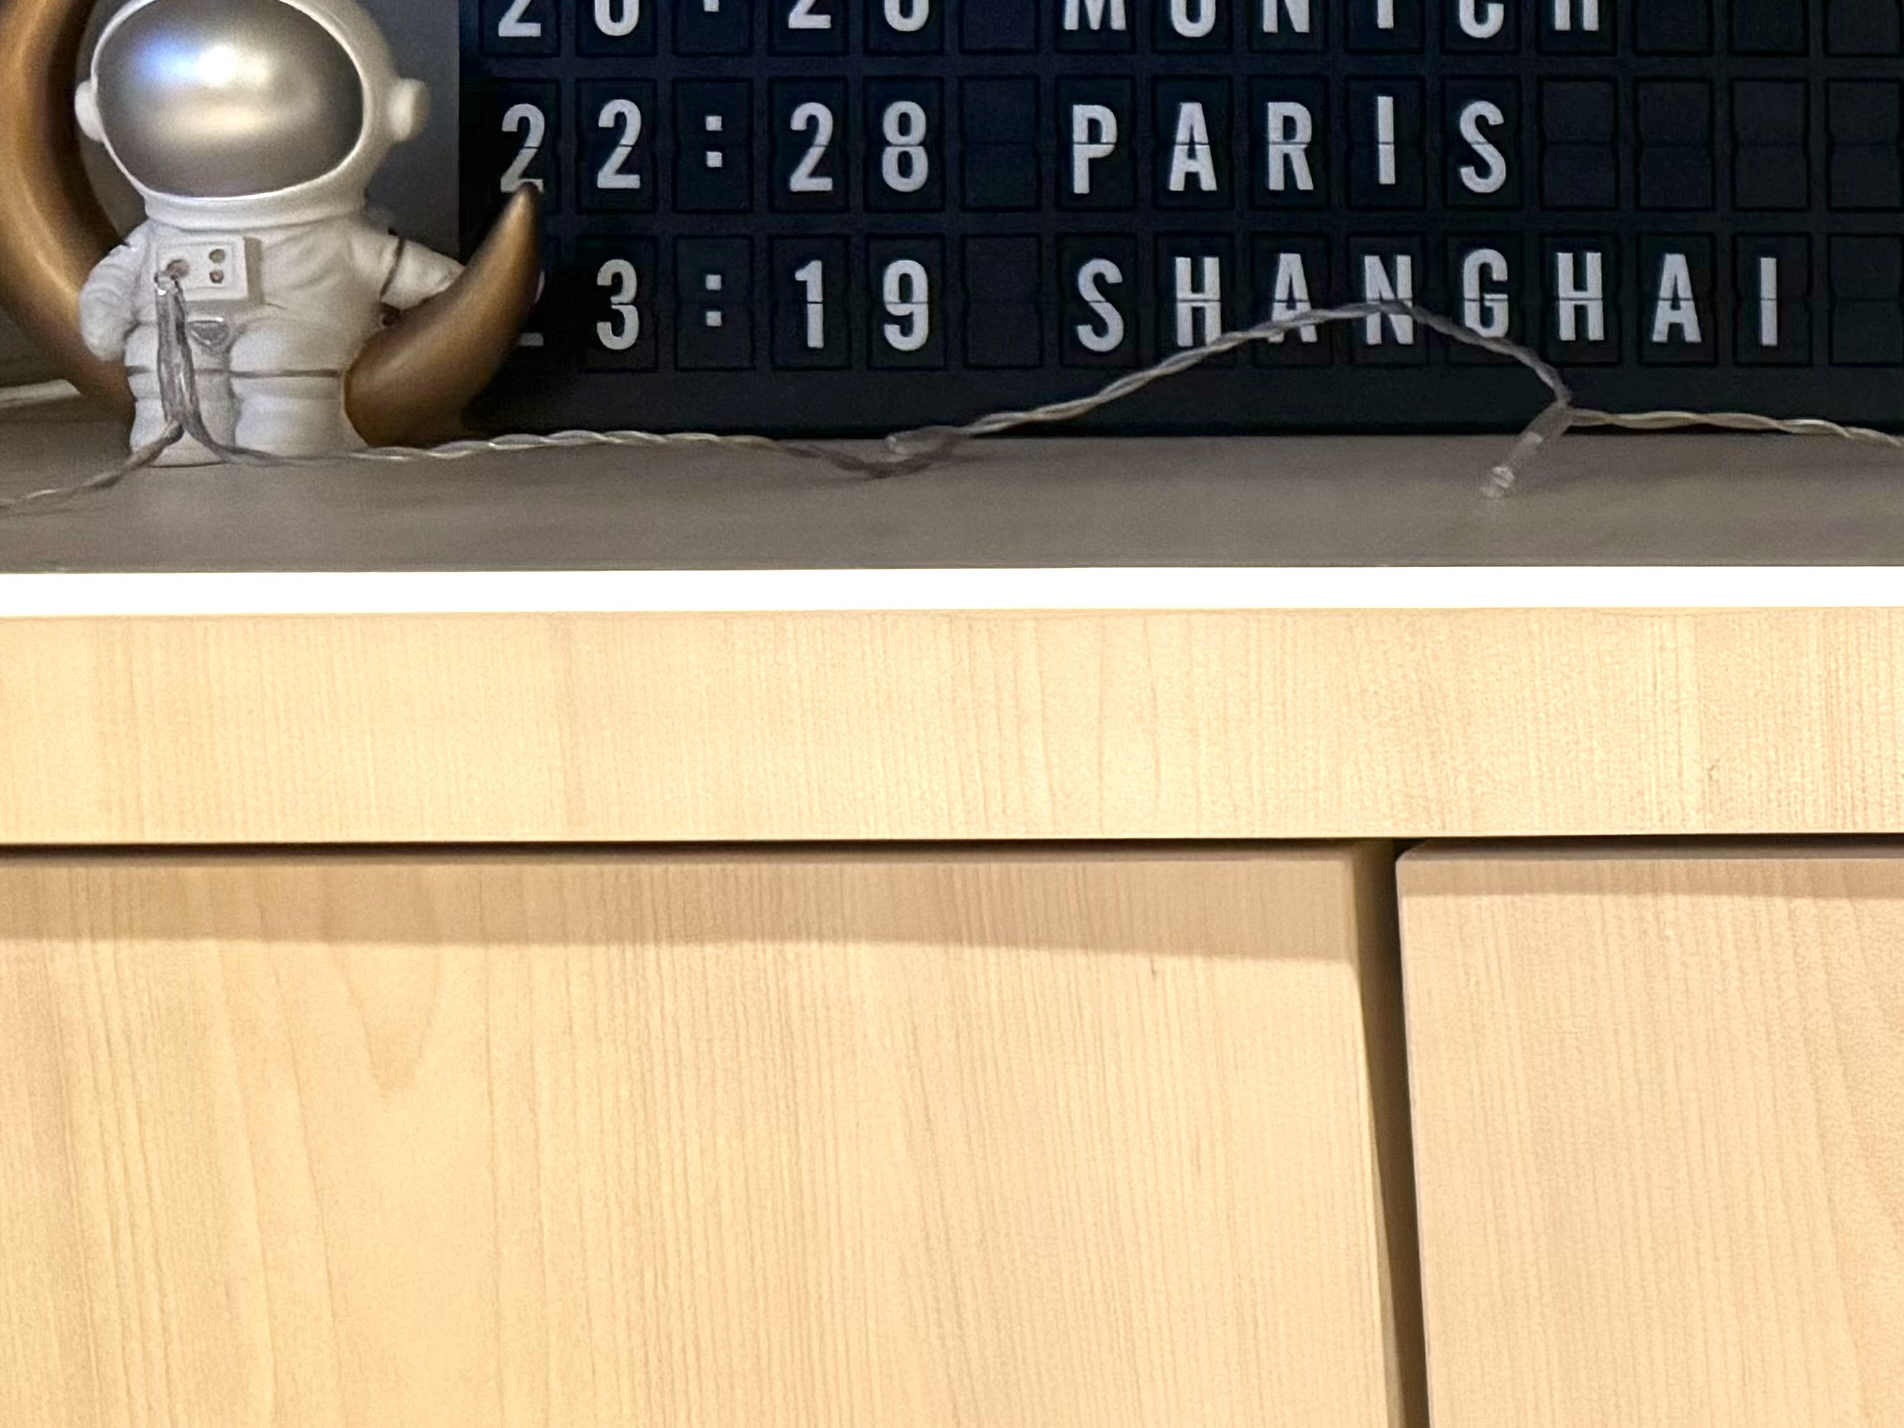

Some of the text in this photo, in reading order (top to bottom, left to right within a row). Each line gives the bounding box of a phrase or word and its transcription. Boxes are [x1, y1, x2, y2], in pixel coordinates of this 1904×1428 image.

[500, 94, 1507, 195] 22:28 PARIS
[518, 247, 1779, 353] 3:19 SHANGHAI
